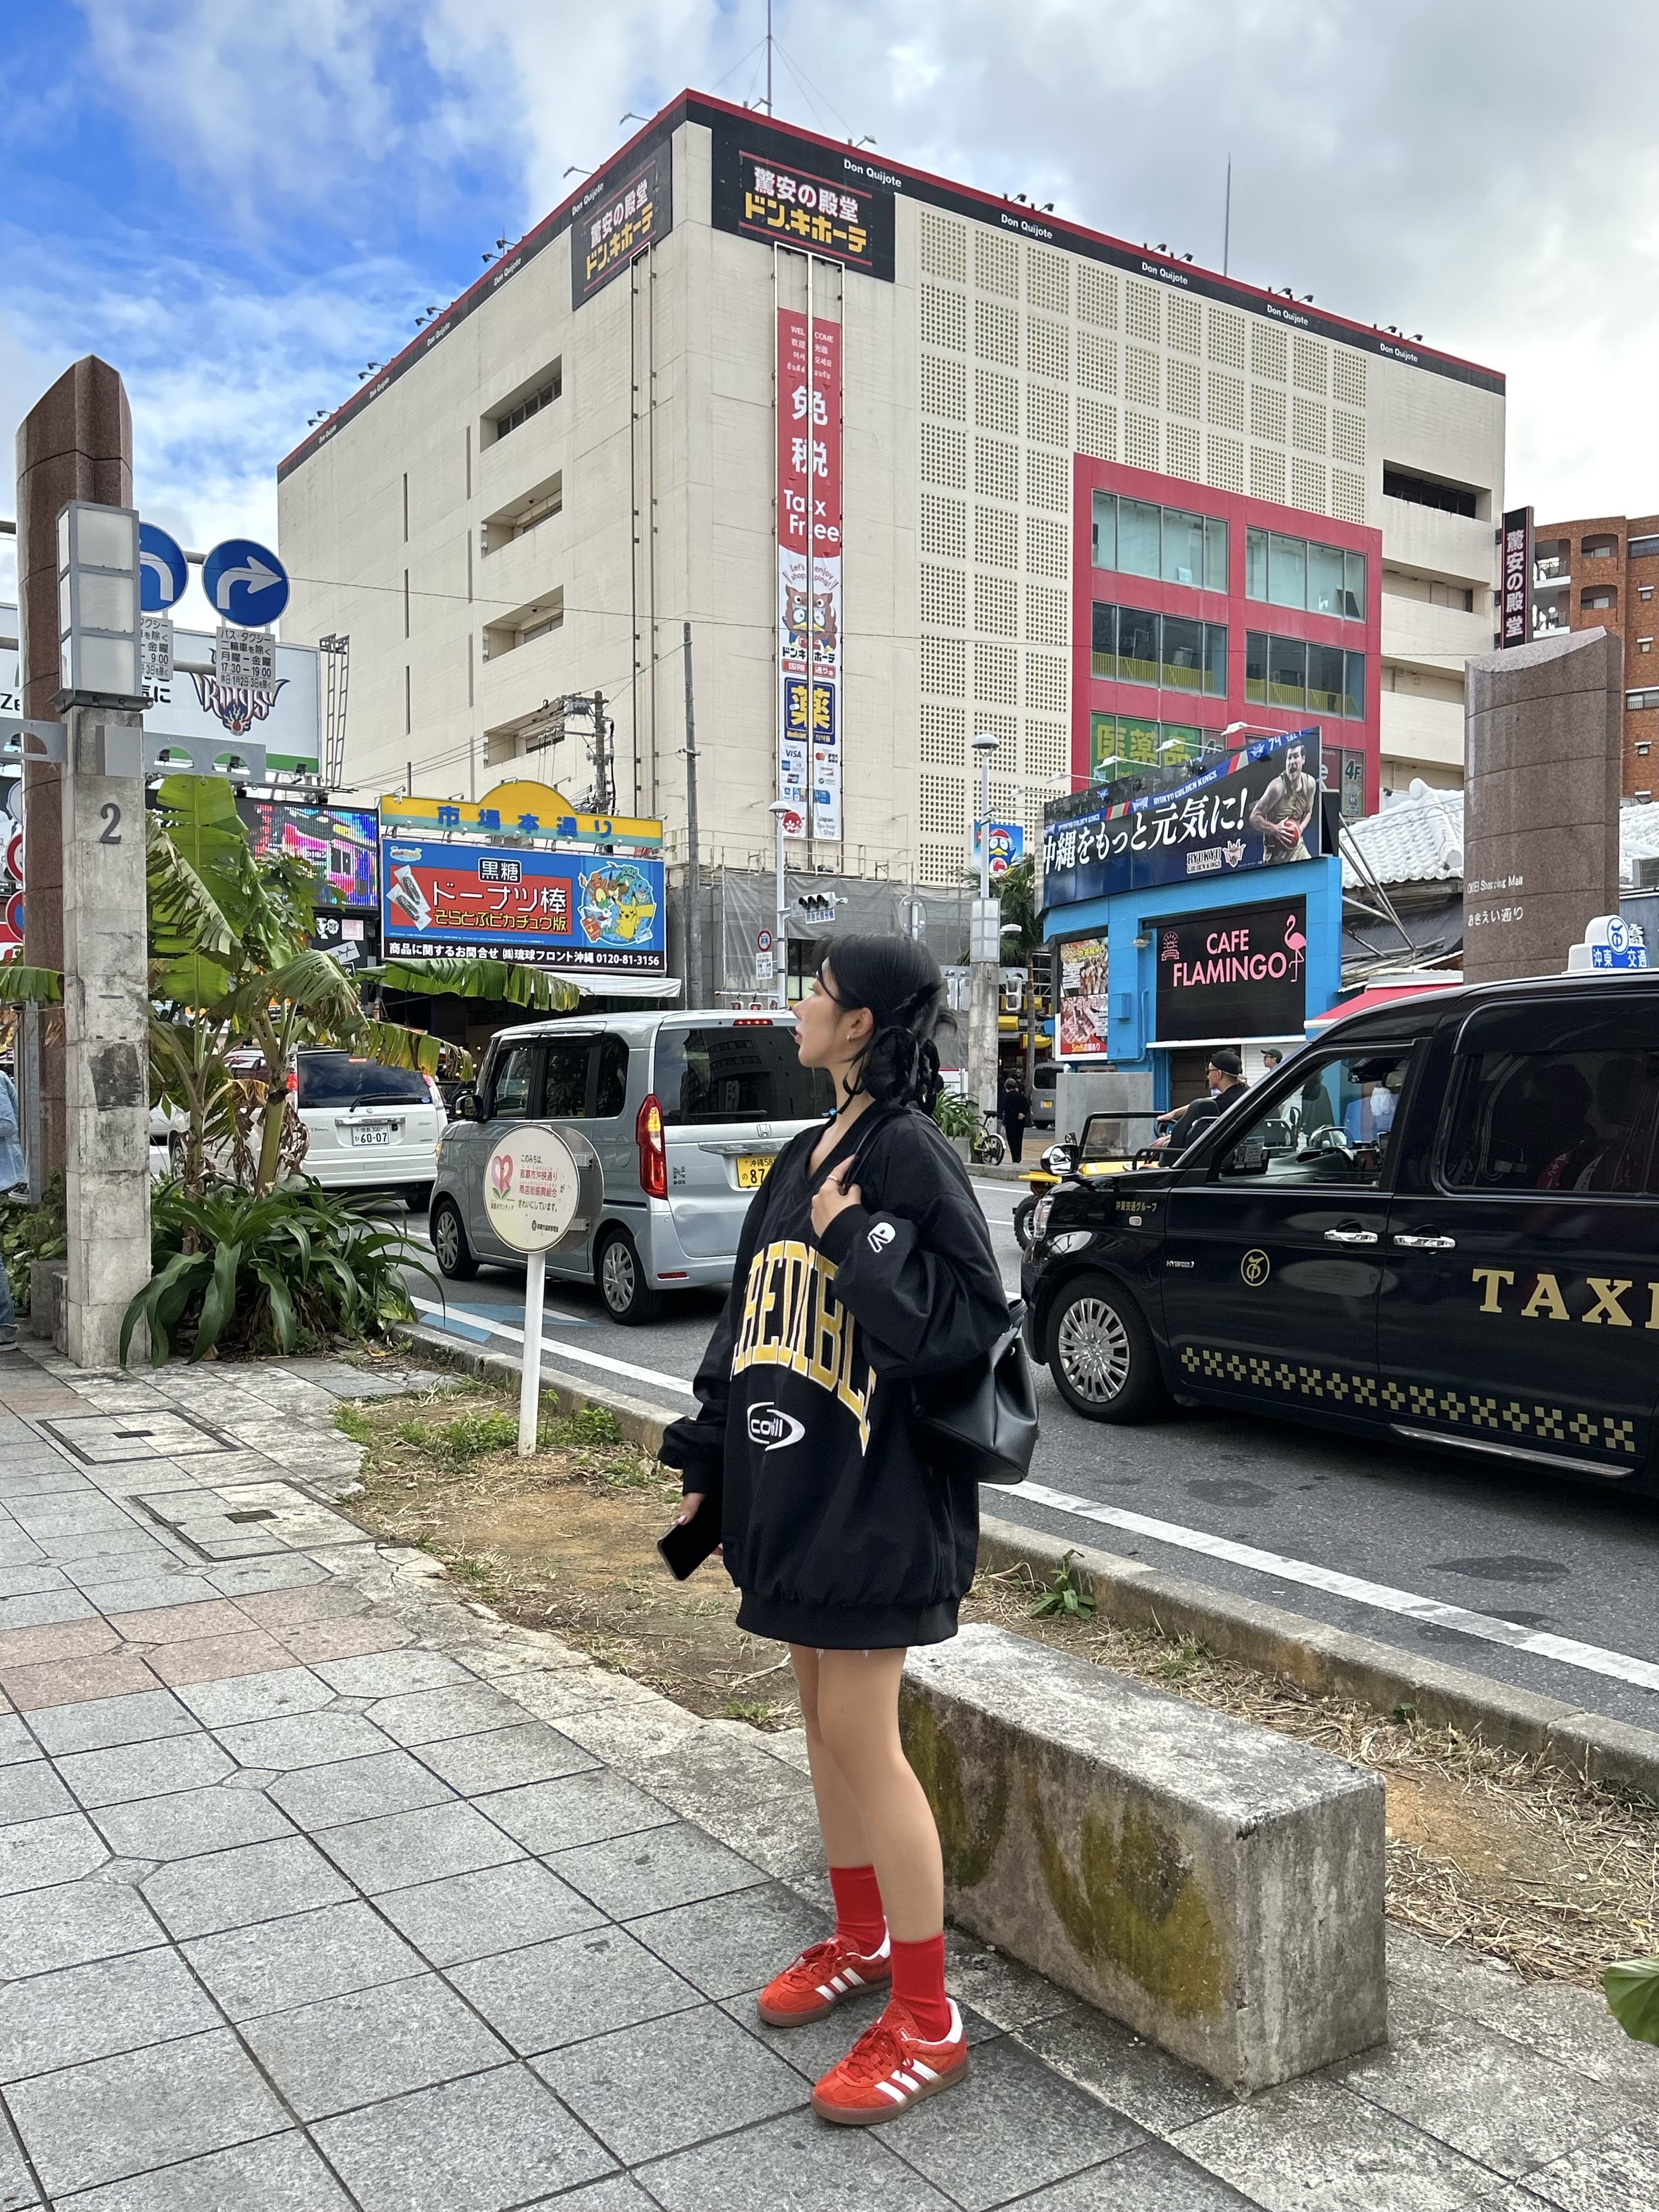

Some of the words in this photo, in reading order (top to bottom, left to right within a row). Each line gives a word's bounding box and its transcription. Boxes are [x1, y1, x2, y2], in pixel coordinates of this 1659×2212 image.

[844, 158, 863, 174] Don
[865, 165, 902, 188] Quijote
[571, 200, 583, 216] Don
[584, 182, 604, 208] Quijote
[754, 164, 859, 225] 驚安の殿堂
[590, 178, 649, 249] 驚安の殿堂
[1001, 213, 1018, 228] Don
[1021, 221, 1053, 239] Quijote
[1142, 261, 1157, 275] Don
[1160, 267, 1188, 285] Quijote
[1267, 304, 1281, 317] Don
[1283, 310, 1309, 326] Quijote
[1380, 343, 1393, 355] Don
[1395, 348, 1418, 363] Quijote
[791, 384, 828, 478] 免税
[783, 489, 827, 517] Tax
[789, 514, 840, 542] Free
[1506, 529, 1524, 639] 驚安の殿堂
[141, 629, 168, 642] を除く
[221, 640, 271, 656] 二輪車を除く
[791, 685, 830, 729] 薬
[785, 749, 802, 758] VISA
[1097, 724, 1191, 766] 医薬品
[1198, 770, 1218, 786] KINGS
[1344, 760, 1362, 780] 4F
[100, 803, 121, 844] 2
[438, 805, 612, 838] 市場本通り
[1188, 848, 1221, 865] RYUKYU
[481, 861, 519, 881] 黒糖
[1508, 875, 1523, 887] Mall
[433, 880, 567, 915] ドーナツ棒
[434, 909, 567, 932] そらとぶピカチュウ版
[1468, 906, 1523, 927] おきえい通り
[389, 942, 499, 959] 商品に関するお問合せ
[596, 954, 660, 966] 0120-81-3156
[1206, 929, 1249, 954] CAFE
[1173, 951, 1287, 987] FLAMINGO
[361, 1133, 387, 1143] 60-07
[1472, 1268, 1659, 1330] TAXI
